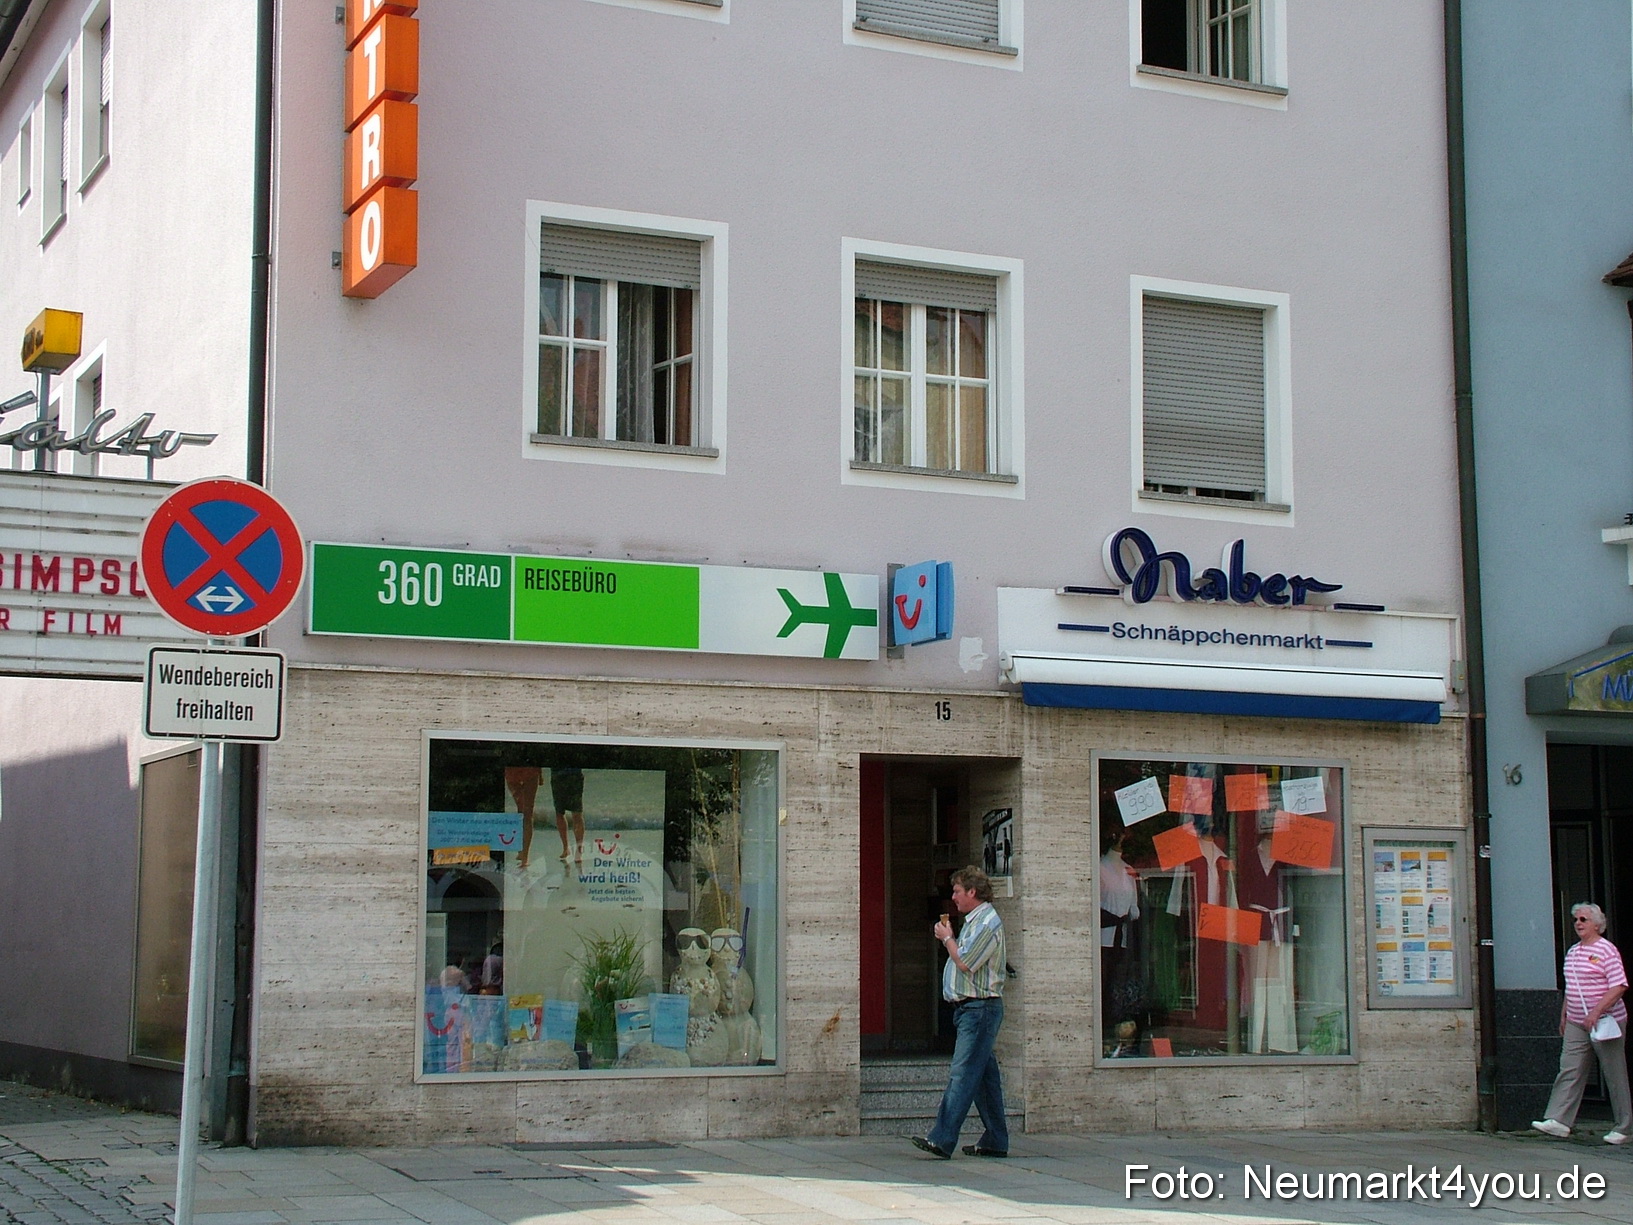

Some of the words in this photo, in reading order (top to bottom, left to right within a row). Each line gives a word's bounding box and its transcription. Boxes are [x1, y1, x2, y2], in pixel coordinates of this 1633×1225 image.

[0, 553, 147, 597] IMPSO
[378, 560, 443, 606] 360
[452, 563, 501, 588] GRAD
[524, 567, 617, 594] REISEBÜRO
[43, 610, 122, 636] FILM
[1112, 622, 1323, 649] Schnäppchenmarkt
[159, 663, 274, 690] Wendebereich
[176, 698, 253, 722] freihalten
[935, 701, 951, 721] 15
[1503, 763, 1523, 785] 16
[594, 857, 613, 868] Der
[616, 857, 652, 868] Winter
[578, 872, 606, 883] wird
[609, 871, 641, 884] heiß!
[591, 895, 619, 903] Angebote
[615, 888, 636, 896] besten
